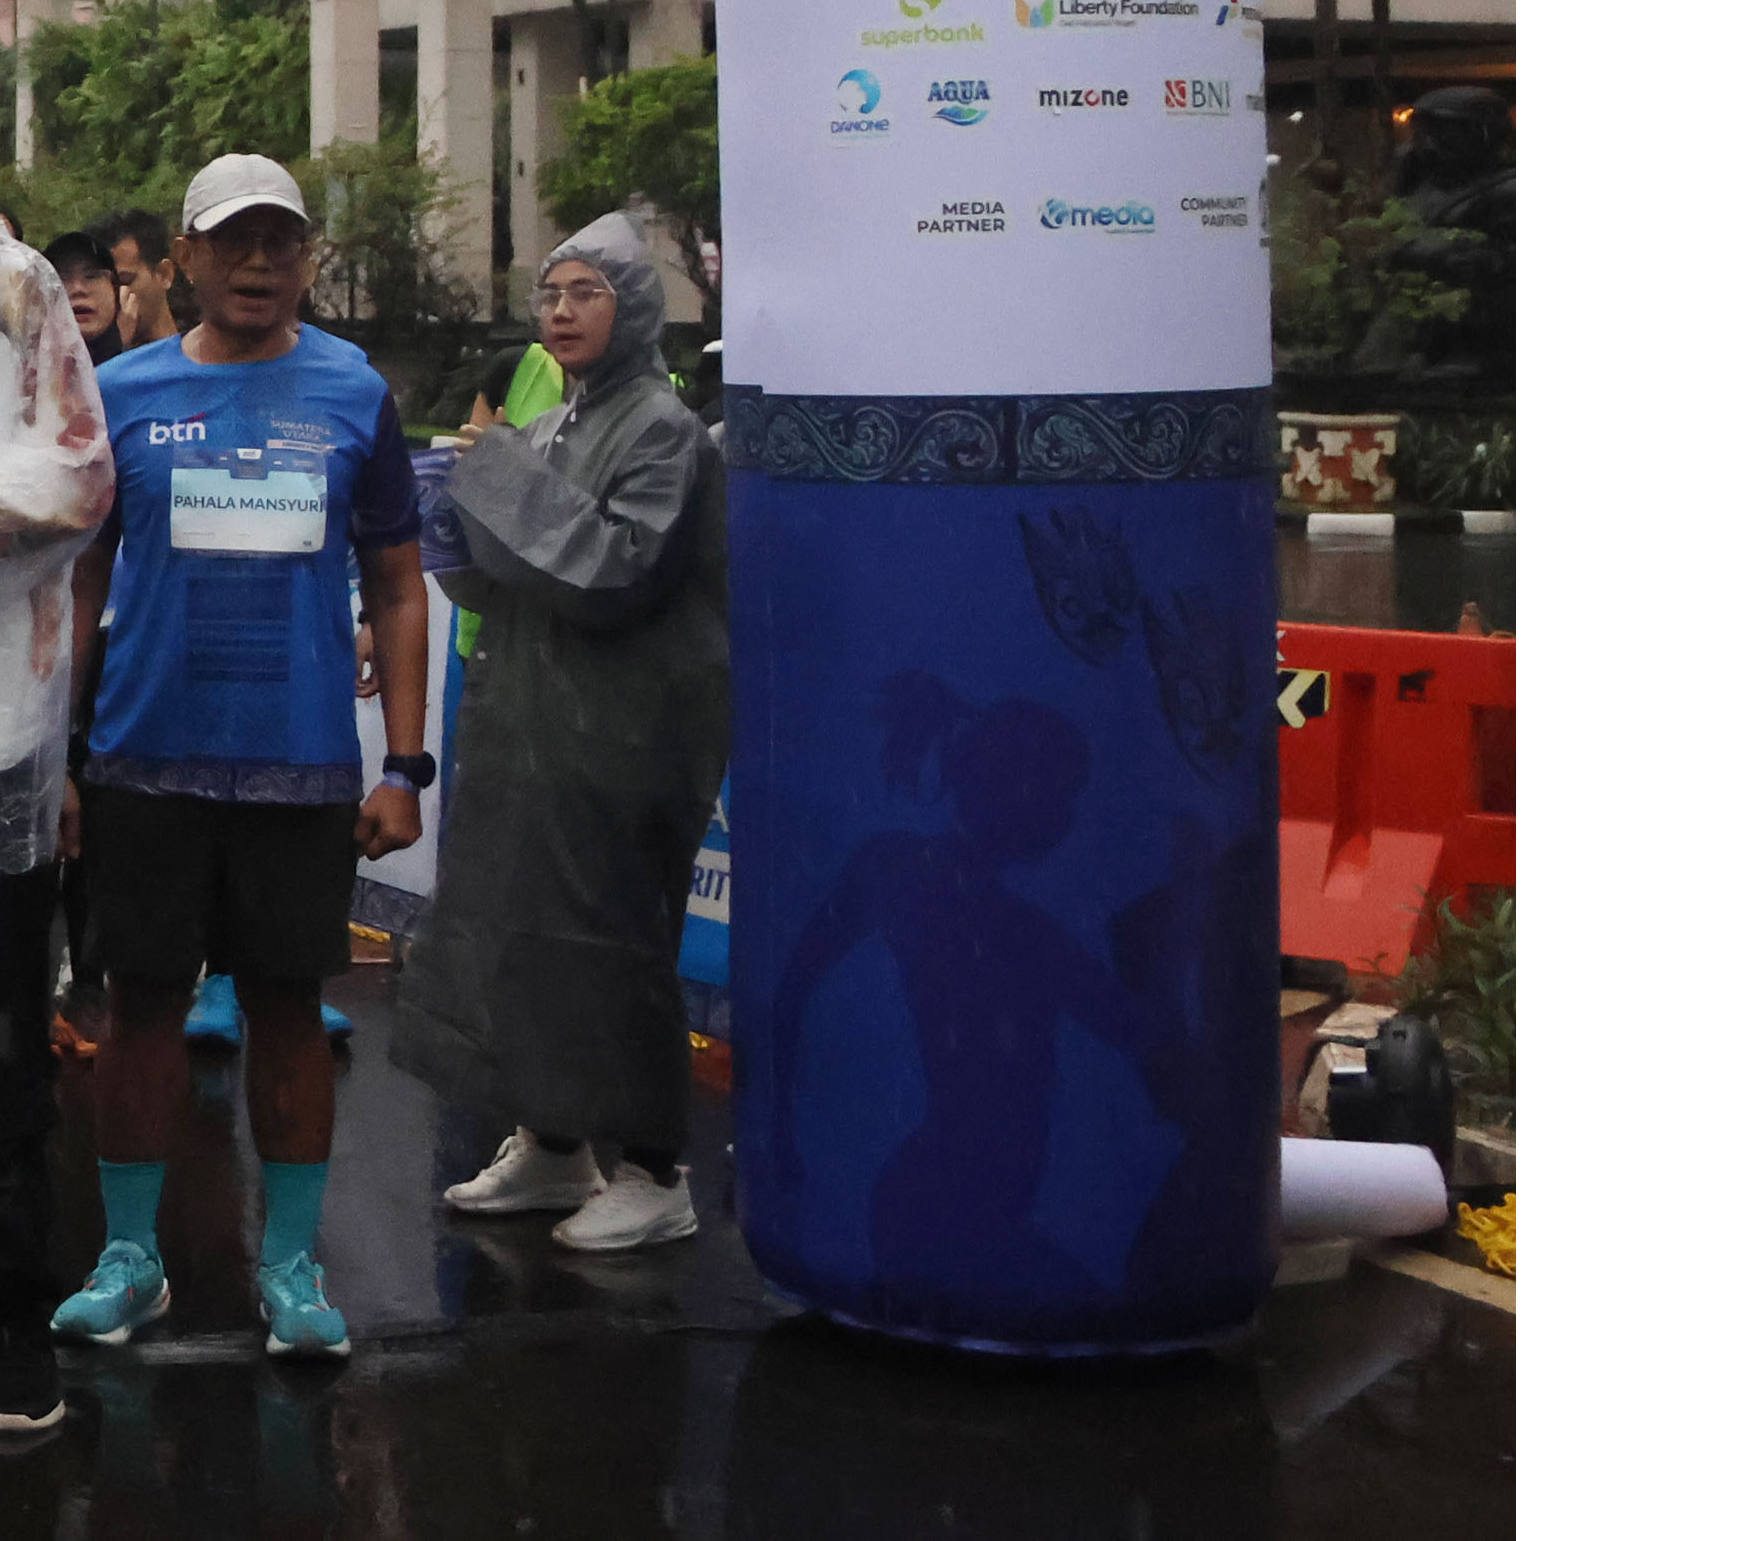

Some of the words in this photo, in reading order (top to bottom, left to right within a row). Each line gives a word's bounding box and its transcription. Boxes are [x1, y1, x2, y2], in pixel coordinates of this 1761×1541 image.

[1059, 0, 1116, 17] Liberty
[1121, 0, 1199, 15] Foundation
[860, 23, 984, 48] superbank
[927, 80, 991, 104] AQUA
[1039, 89, 1128, 107] mizone
[1192, 80, 1231, 108] BNI
[942, 201, 1005, 215] MEDIA
[917, 219, 1006, 233] PARTNER
[149, 412, 206, 445] btn
[174, 495, 235, 509] PAHALA
[239, 498, 323, 512] MANSYURI
